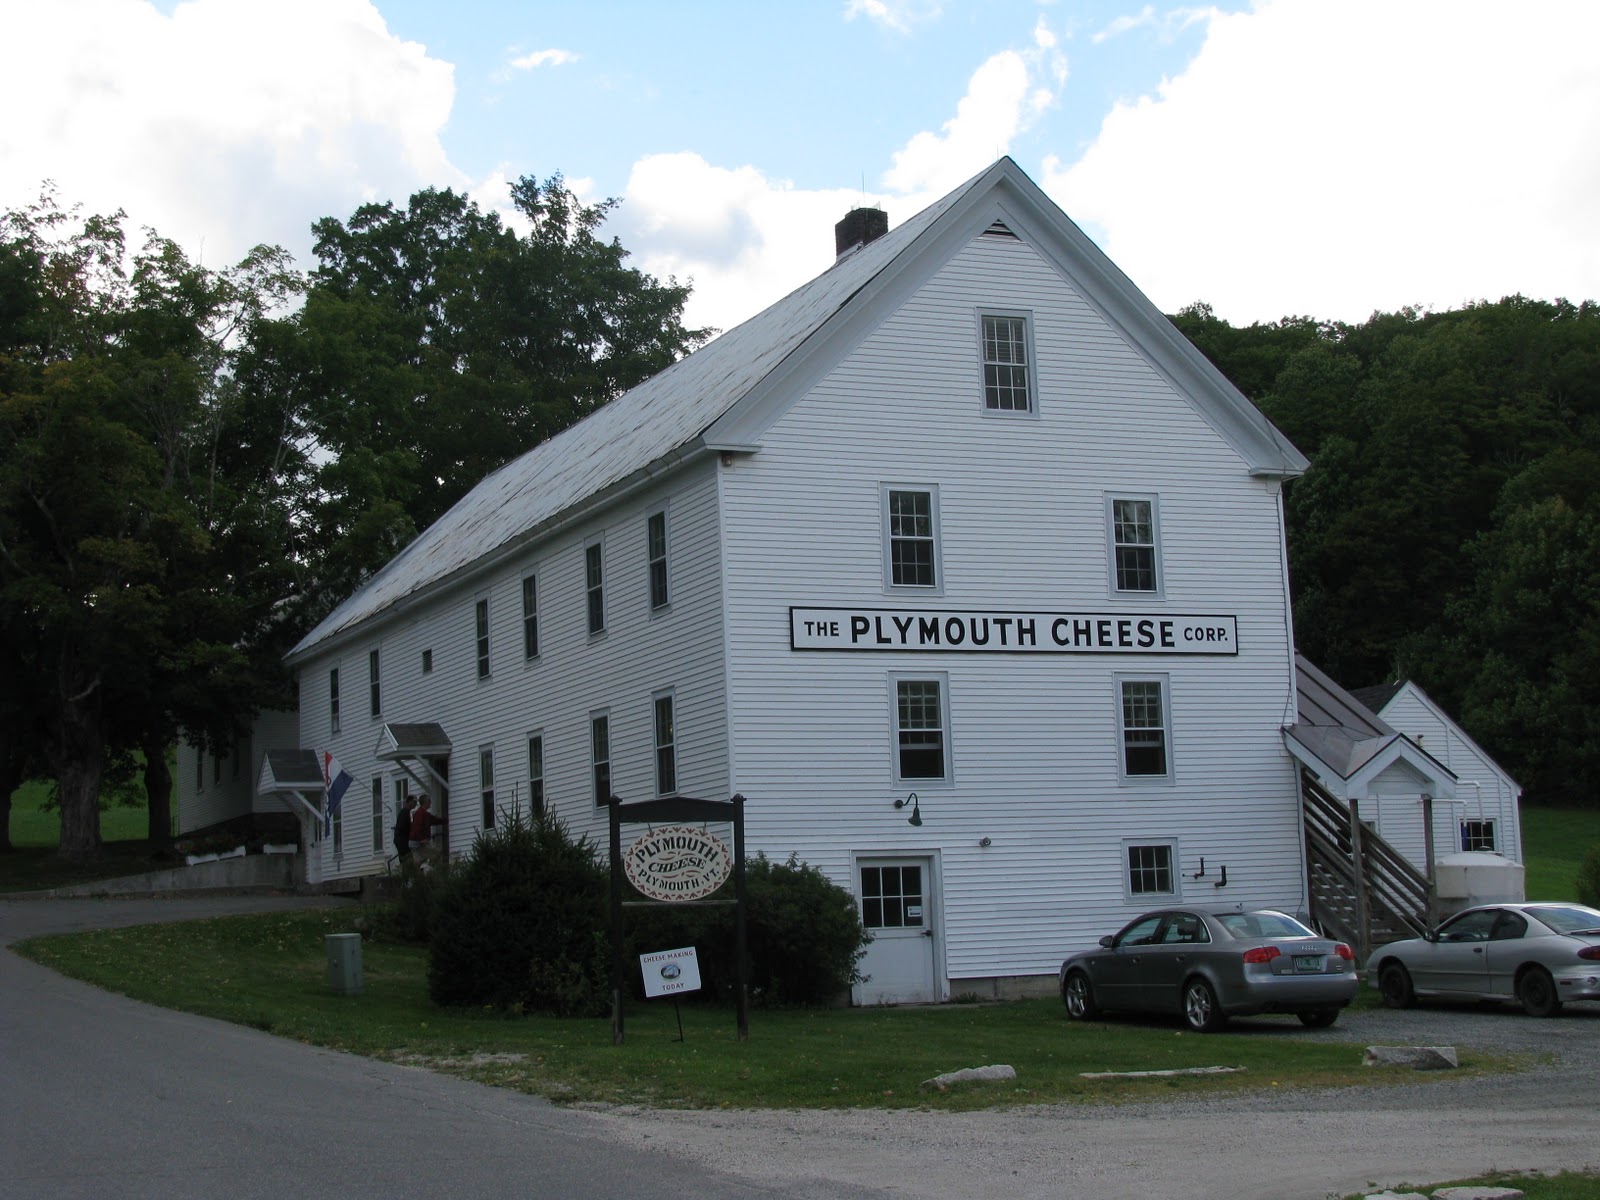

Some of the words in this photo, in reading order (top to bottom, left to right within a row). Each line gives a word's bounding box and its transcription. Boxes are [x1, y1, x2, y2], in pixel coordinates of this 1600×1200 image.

[804, 621, 839, 637] THE
[850, 616, 1037, 647] PLYMOUTH
[1051, 618, 1176, 648] CHEESE
[1183, 627, 1229, 642] CORP.
[635, 836, 719, 864] PLYMOUTH
[648, 857, 707, 873] CHEESE
[643, 954, 666, 964] CHEESE
[667, 950, 693, 960] MAKING
[662, 982, 685, 991] TODAY
